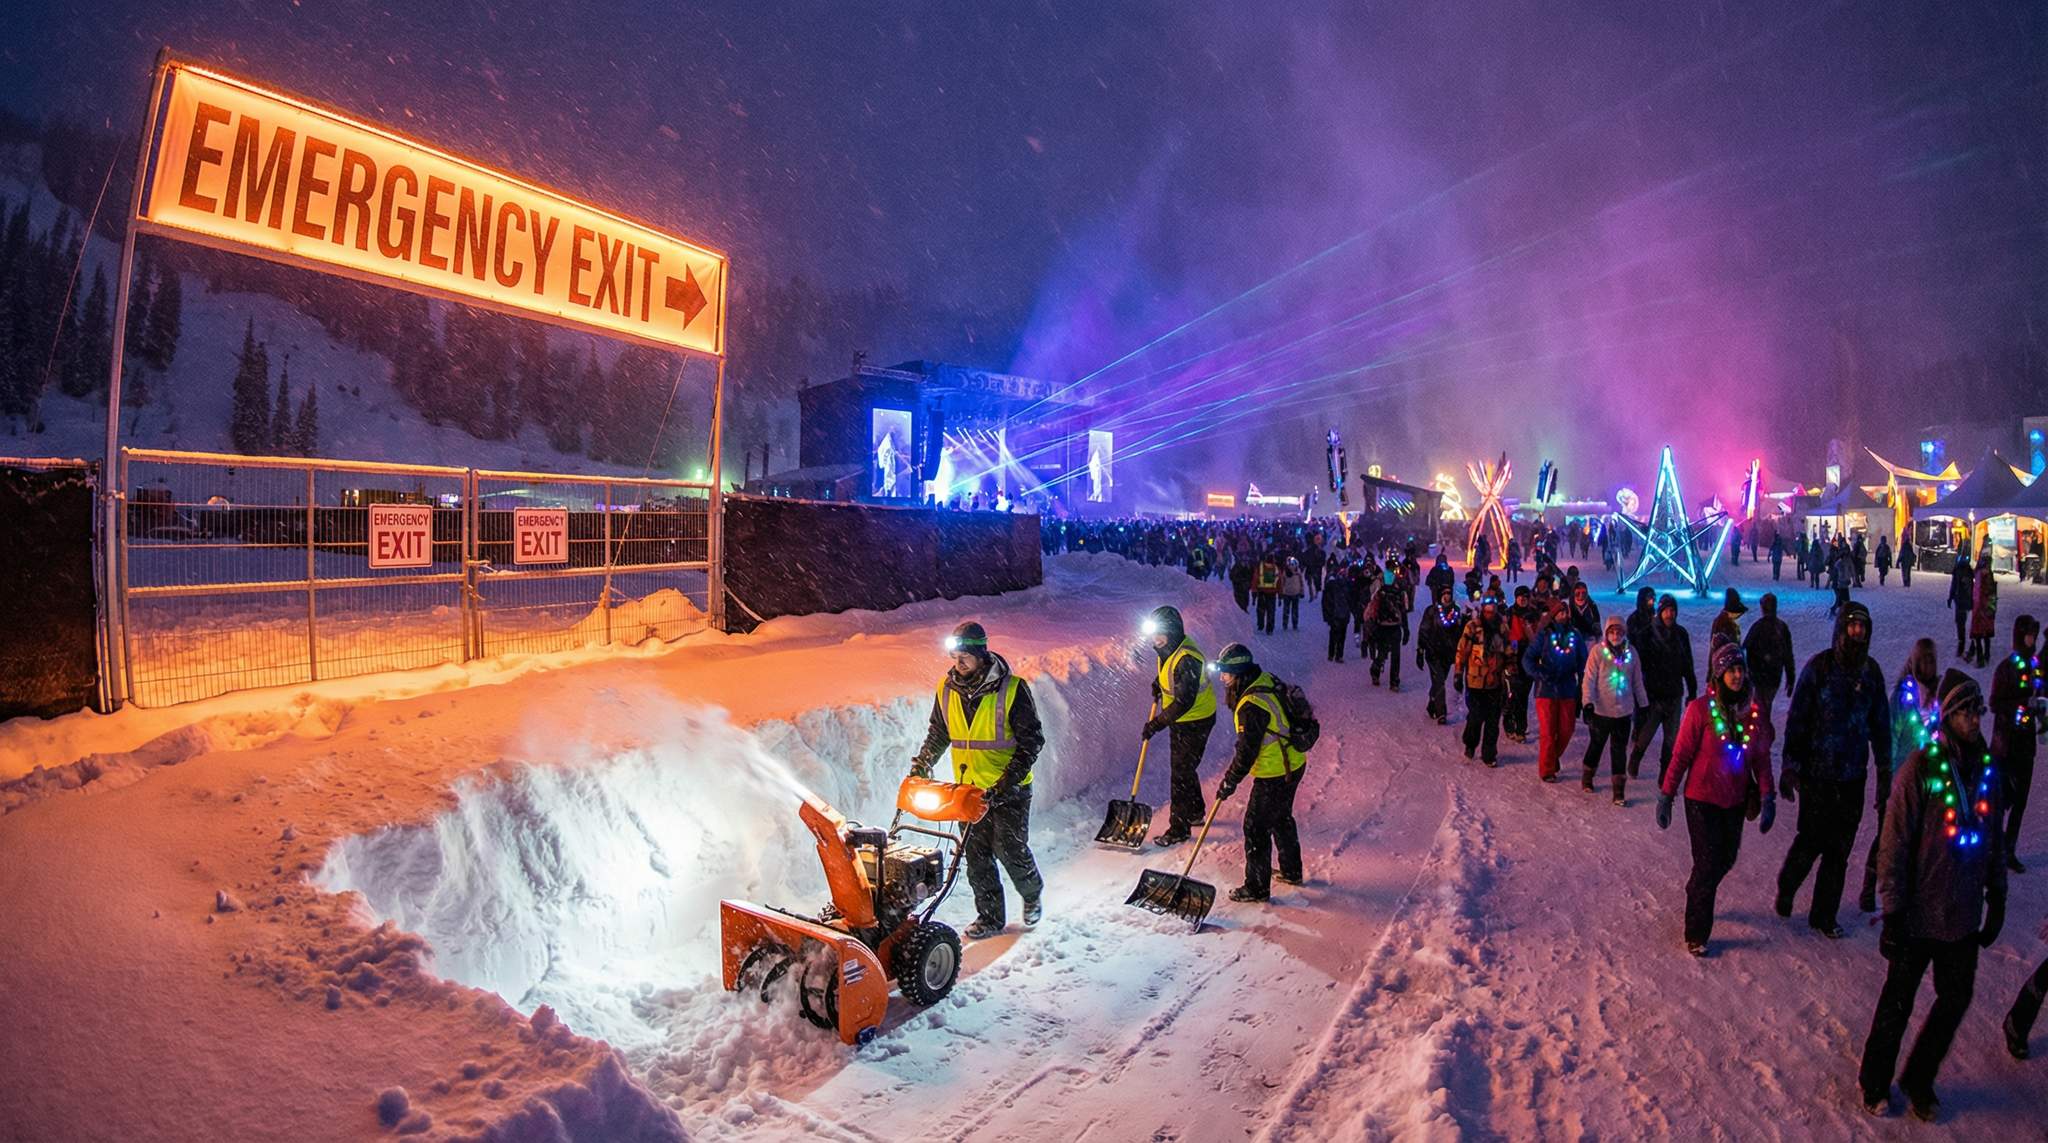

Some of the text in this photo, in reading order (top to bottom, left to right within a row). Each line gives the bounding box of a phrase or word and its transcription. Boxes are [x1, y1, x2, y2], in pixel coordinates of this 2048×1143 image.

[179, 101, 660, 322] EMERGENCY EXIT
[374, 513, 429, 526] EMERGENCY
[378, 531, 426, 559] EXIT
[521, 531, 562, 556] EXIT
